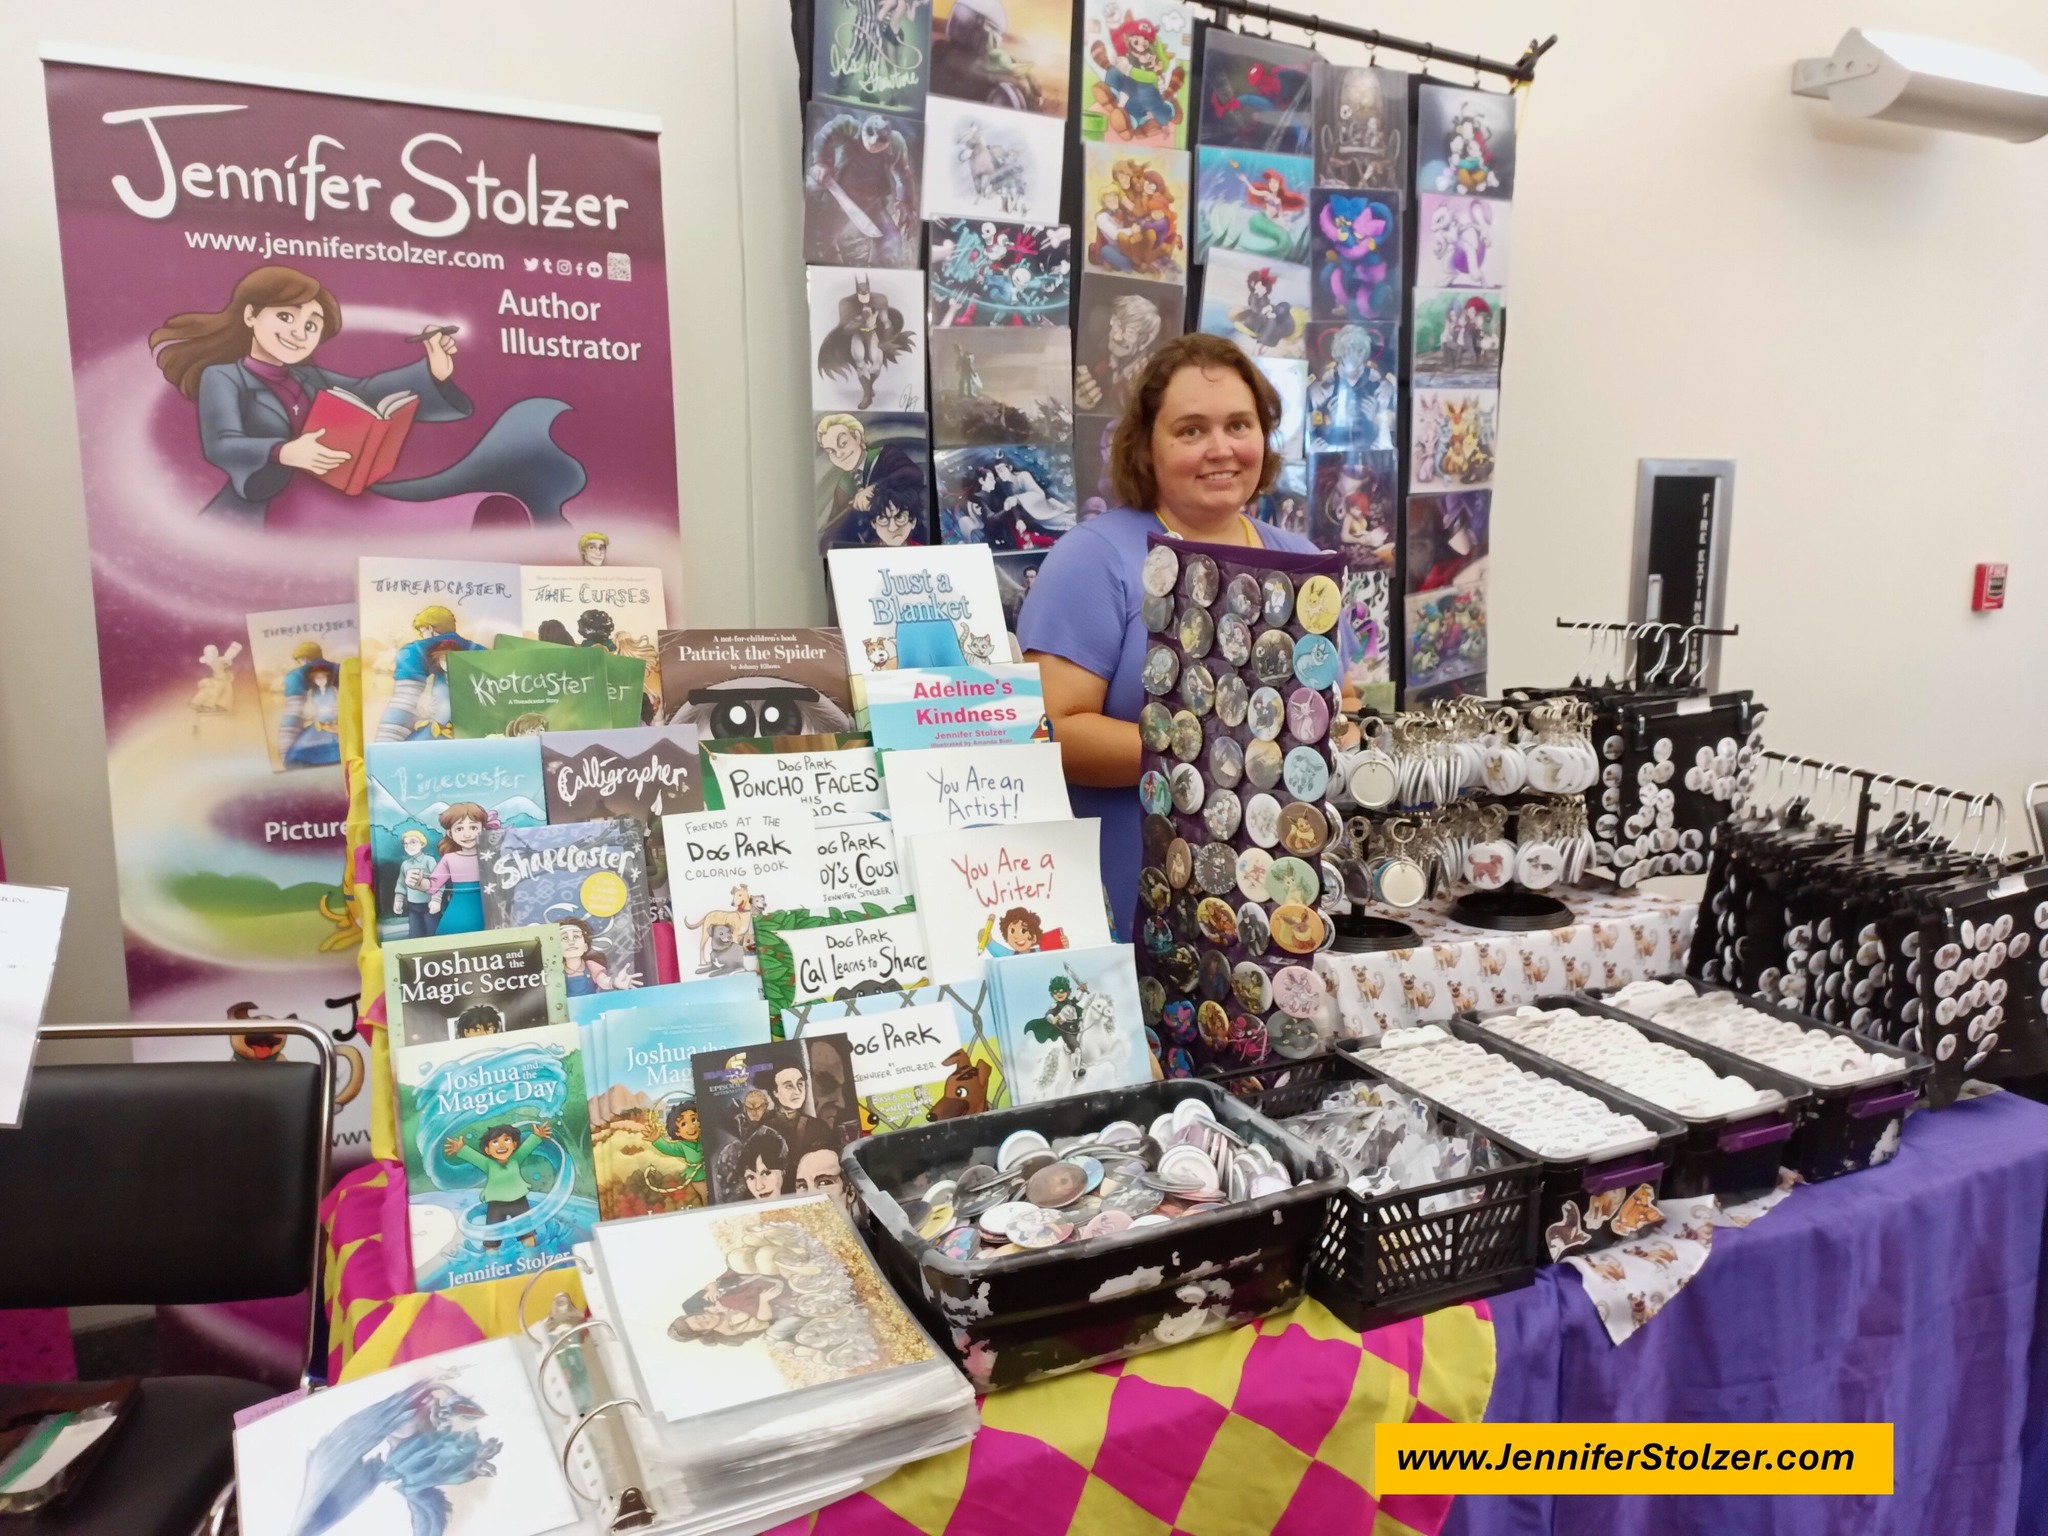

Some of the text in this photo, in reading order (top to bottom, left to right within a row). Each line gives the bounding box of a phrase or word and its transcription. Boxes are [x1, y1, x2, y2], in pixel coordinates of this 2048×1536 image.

[102, 103, 630, 238] Jennifer Stolzer
[184, 230, 505, 271] www.jenniferstolzer.com
[498, 288, 601, 322] Author
[500, 328, 641, 362] Illustrator
[1699, 493, 1711, 544] FIRE
[579, 583, 651, 607] CURSES
[877, 568, 954, 597] Just a
[867, 593, 973, 626] Blanket
[781, 634, 797, 642] book
[678, 644, 827, 663] Patrick the Spider
[469, 669, 595, 707] Knotcaster
[913, 679, 1013, 699] Adeline's
[916, 707, 1017, 726] Kindness
[935, 728, 1007, 740] Jennifer Stolzer
[804, 756, 836, 771] PARK
[557, 754, 688, 808] Calligrapher
[729, 767, 880, 798] PONCHO FACES
[926, 765, 1024, 803] You Are an
[949, 793, 1018, 826] Artist!
[684, 815, 781, 835] FRIENDS AT THE
[734, 832, 792, 858] PARK
[840, 831, 886, 854] PARK
[685, 862, 789, 882] COLORING BOOK
[951, 847, 1055, 889] You Are a
[976, 871, 1054, 909] Writer!
[856, 928, 894, 944] PARK
[412, 948, 525, 985] Joshua and
[508, 957, 525, 969] the
[800, 946, 928, 993] Cal Learns to Share
[400, 969, 550, 1005] Magic Secret
[882, 1022, 942, 1051] PARK
[626, 1042, 698, 1072] Joshua
[854, 1061, 936, 1083] JENNIFER STOLZER
[444, 1060, 539, 1097] Joshua and
[521, 1069, 537, 1081] the
[647, 1065, 693, 1087] Mag
[438, 1079, 558, 1115] Magic Day
[448, 1250, 571, 1288] Jennifer Stolzer
